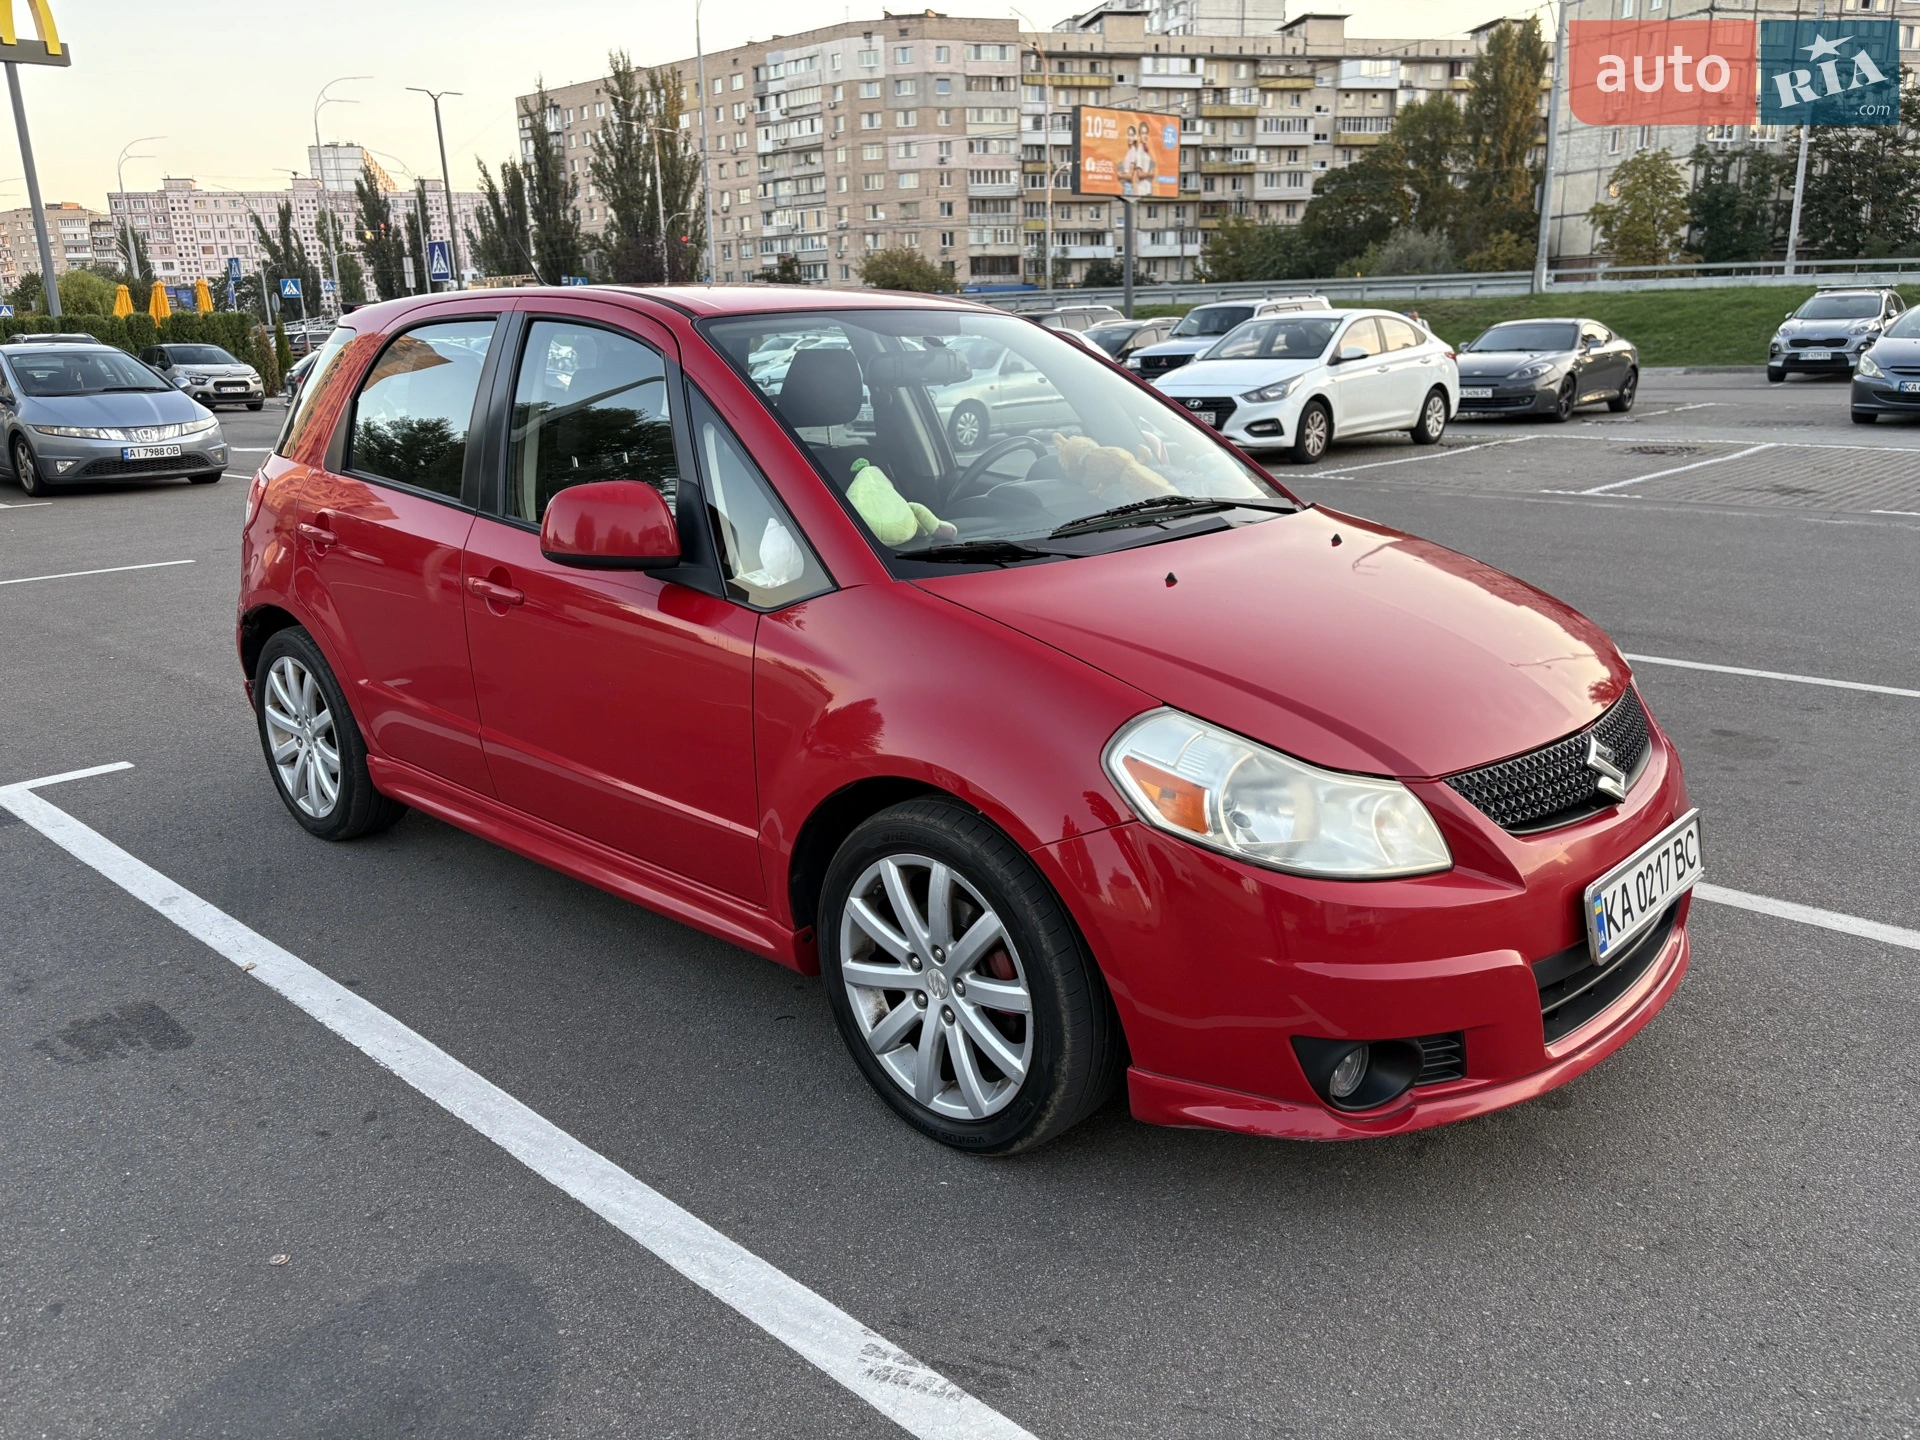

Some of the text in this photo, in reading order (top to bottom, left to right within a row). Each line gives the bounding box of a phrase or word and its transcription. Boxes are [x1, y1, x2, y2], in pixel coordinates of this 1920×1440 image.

[1085, 115, 1102, 138] 10
[1905, 383, 1917, 391] KA
[129, 449, 141, 458] AI
[143, 447, 165, 457] 7988
[1603, 829, 1697, 940] KA 0217 BC
